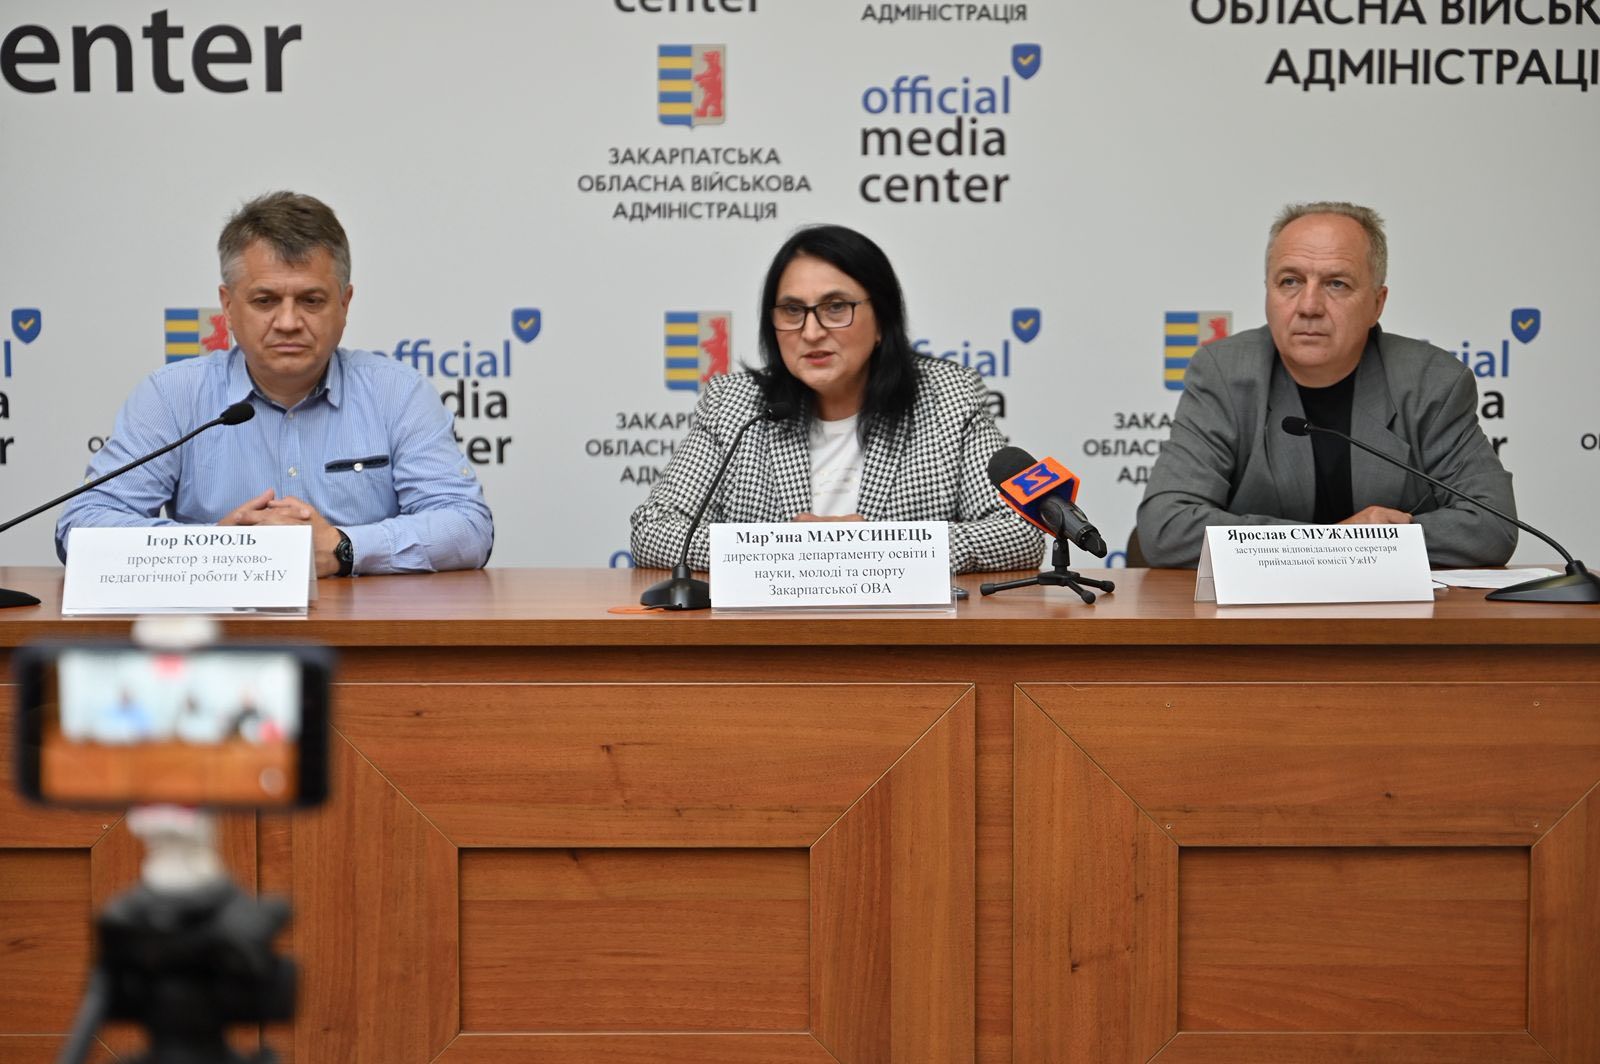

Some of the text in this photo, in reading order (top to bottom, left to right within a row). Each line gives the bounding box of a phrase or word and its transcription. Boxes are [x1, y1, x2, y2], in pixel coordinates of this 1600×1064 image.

[861, 4, 1028, 24] АДМІНІСТРАЦІЯ
[1190, 0, 1427, 25] ОБЛАСНА
[0, 9, 303, 94] enter
[1265, 48, 1600, 92] АДМІНІСТРАЦІ
[861, 75, 1010, 114] official
[861, 115, 1006, 156] media
[608, 147, 781, 165] ЗАКАРПАТСЬКА
[577, 171, 812, 193] ОБЛАСНА ВІЙСЬКОВА
[859, 168, 1010, 203] center
[612, 201, 777, 221] АДМІНІСТРАЦІЯ
[372, 339, 511, 378] fficial
[440, 379, 508, 419] dia
[585, 438, 675, 457] ОБЛАСН
[1083, 439, 1162, 456] ОБЛАС
[146, 533, 257, 549] Ігор КОРОЛЬ
[807, 528, 932, 543] МАРУСИНЕЦЬ
[1227, 527, 1400, 543] Ярослав СМУЖАНИЦЯ
[723, 551, 795, 563] директорка
[798, 549, 885, 562] департаменту
[888, 547, 927, 560] освіти
[1235, 544, 1398, 555] заступник відповідального секретаря
[127, 554, 197, 566] проректор
[212, 554, 272, 566] науково-
[1258, 556, 1378, 568] приймальної комісії УжНУ
[100, 570, 287, 584] педагогічної роботи УжНУ
[754, 565, 906, 581] науки, молоді та спорту
[768, 582, 892, 597] Закарпатської ОВА
